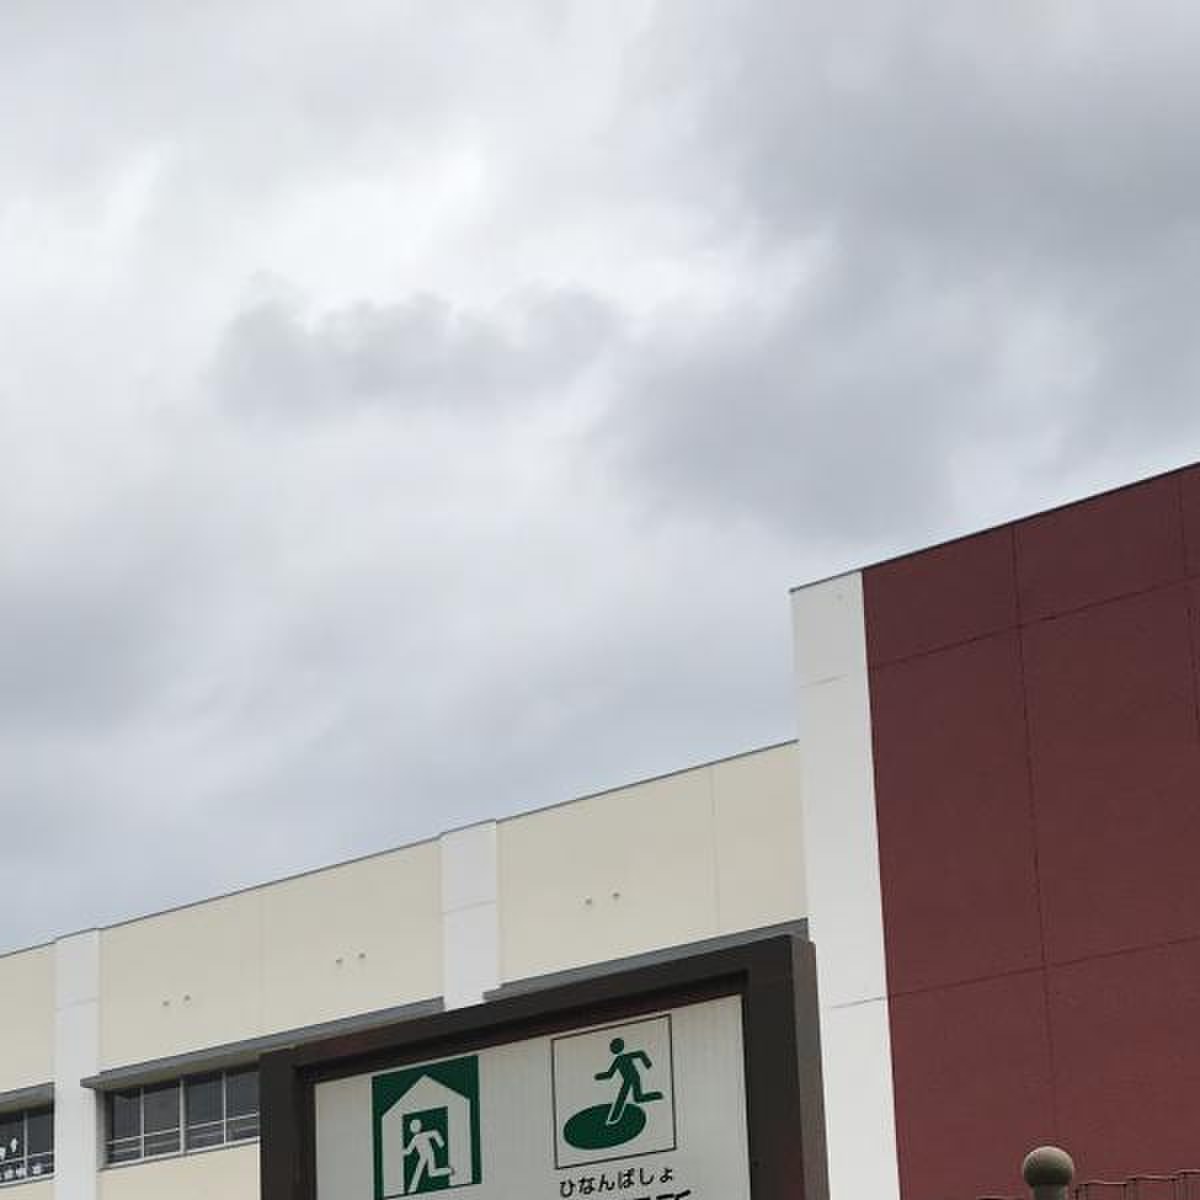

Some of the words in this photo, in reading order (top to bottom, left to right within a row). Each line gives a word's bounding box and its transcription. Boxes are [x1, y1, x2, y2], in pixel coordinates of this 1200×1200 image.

[560, 1167, 673, 1198] ひなんばしょ
